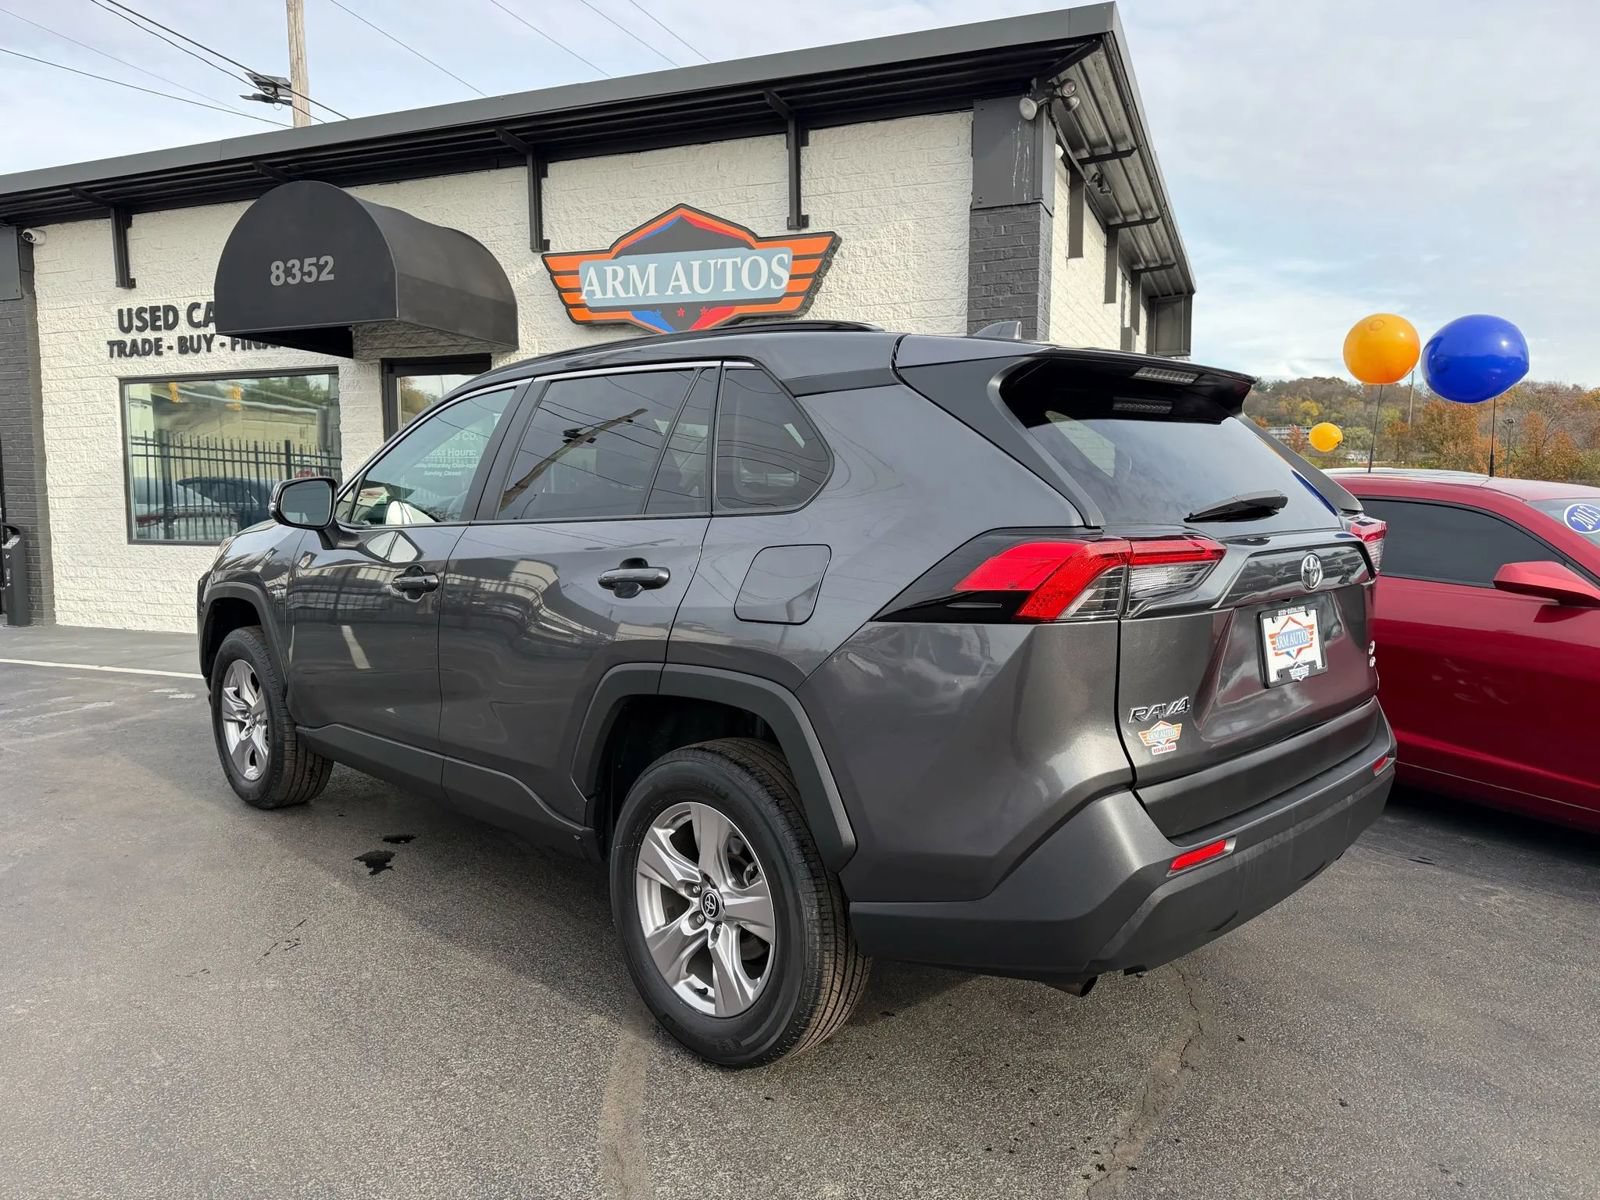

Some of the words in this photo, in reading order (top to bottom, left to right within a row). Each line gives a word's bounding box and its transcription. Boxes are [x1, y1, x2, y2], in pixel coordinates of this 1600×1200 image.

[270, 255, 335, 286] 8352
[579, 263, 658, 300] ARM
[664, 253, 790, 296] AUTOS
[117, 304, 179, 334] USED
[186, 301, 216, 328] CA
[107, 337, 164, 358] TRADE
[177, 333, 216, 355] BUY
[1128, 696, 1190, 724] RAV4
